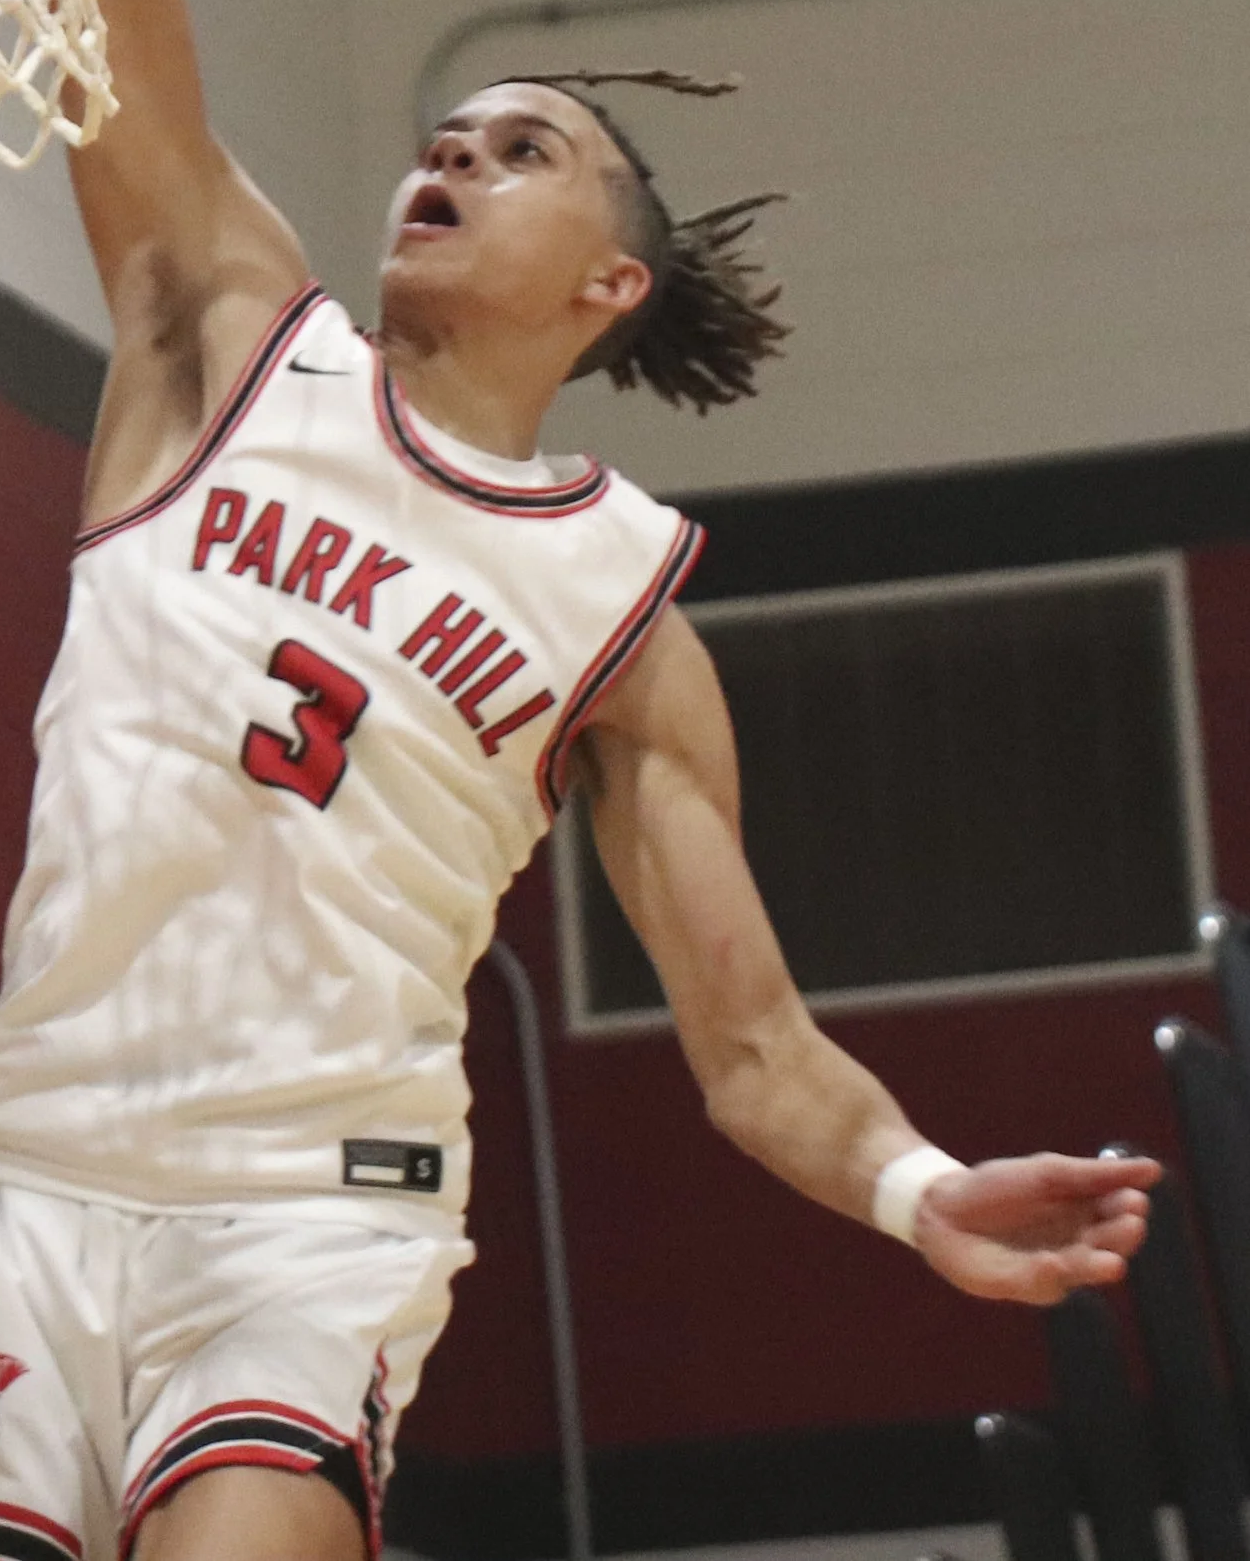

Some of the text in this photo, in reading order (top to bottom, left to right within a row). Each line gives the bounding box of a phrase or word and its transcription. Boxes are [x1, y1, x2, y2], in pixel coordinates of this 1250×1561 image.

[191, 486, 556, 758] PARK HILL
[240, 638, 370, 811] 3
